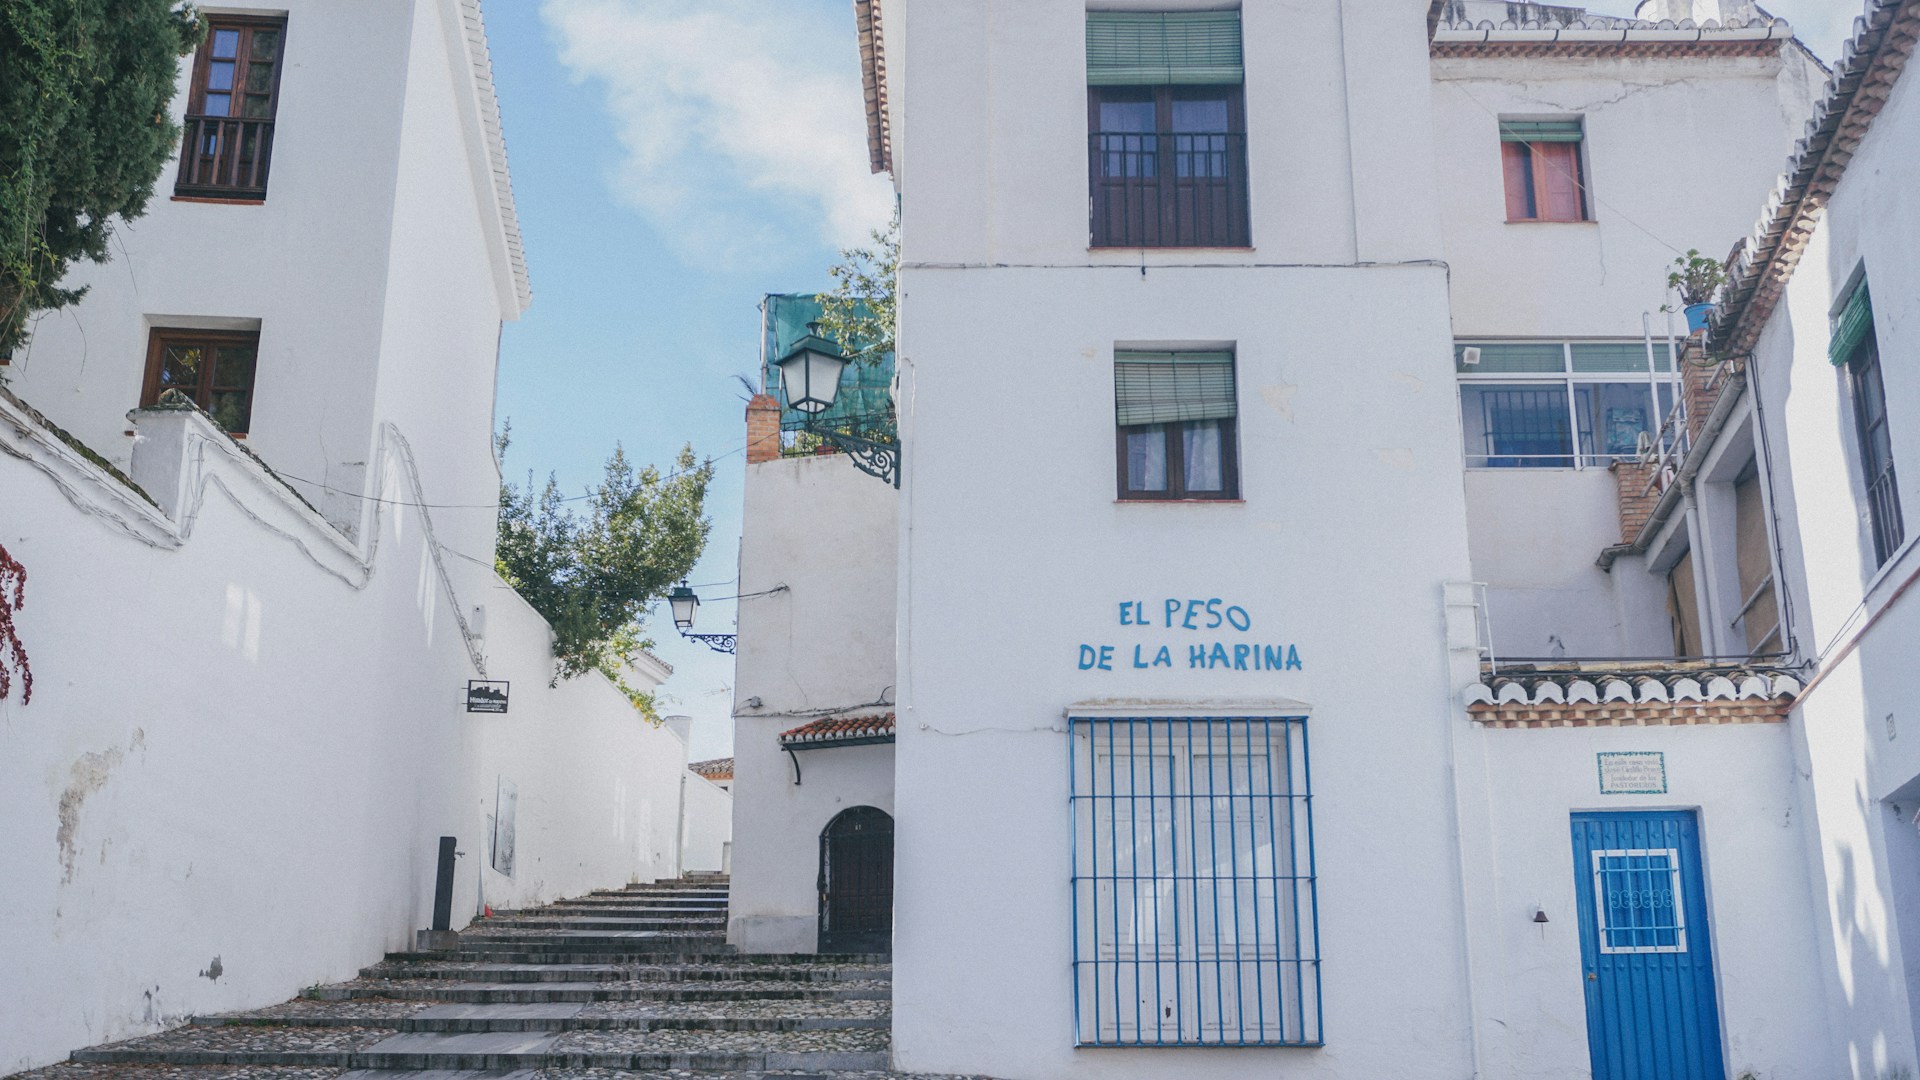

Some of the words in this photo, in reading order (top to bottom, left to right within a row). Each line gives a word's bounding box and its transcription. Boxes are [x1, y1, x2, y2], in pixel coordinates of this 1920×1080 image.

[1119, 600, 1150, 626] EL
[1165, 597, 1251, 632] PESO
[1078, 643, 1115, 671] DE
[1133, 643, 1172, 669] LA
[1189, 642, 1302, 671] HARINA
